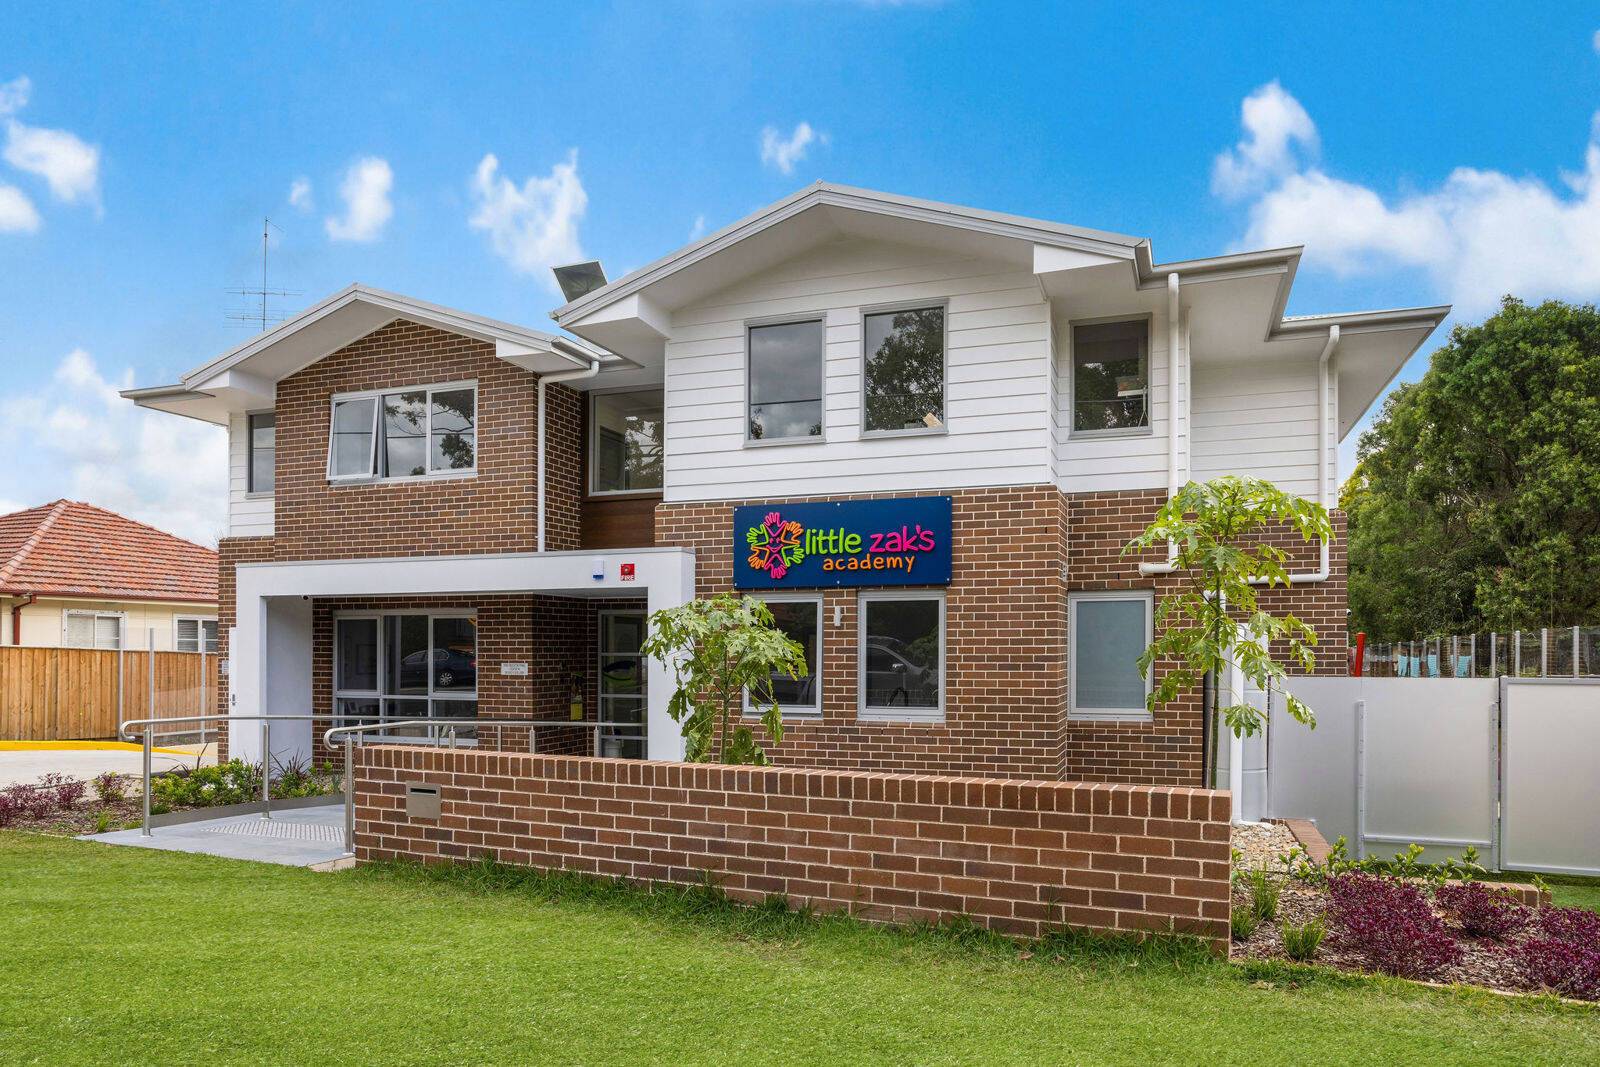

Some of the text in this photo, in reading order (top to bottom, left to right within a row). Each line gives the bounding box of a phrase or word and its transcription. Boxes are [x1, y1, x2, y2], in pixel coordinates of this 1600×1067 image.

[805, 524, 936, 555] little zak's
[822, 553, 915, 573] academy
